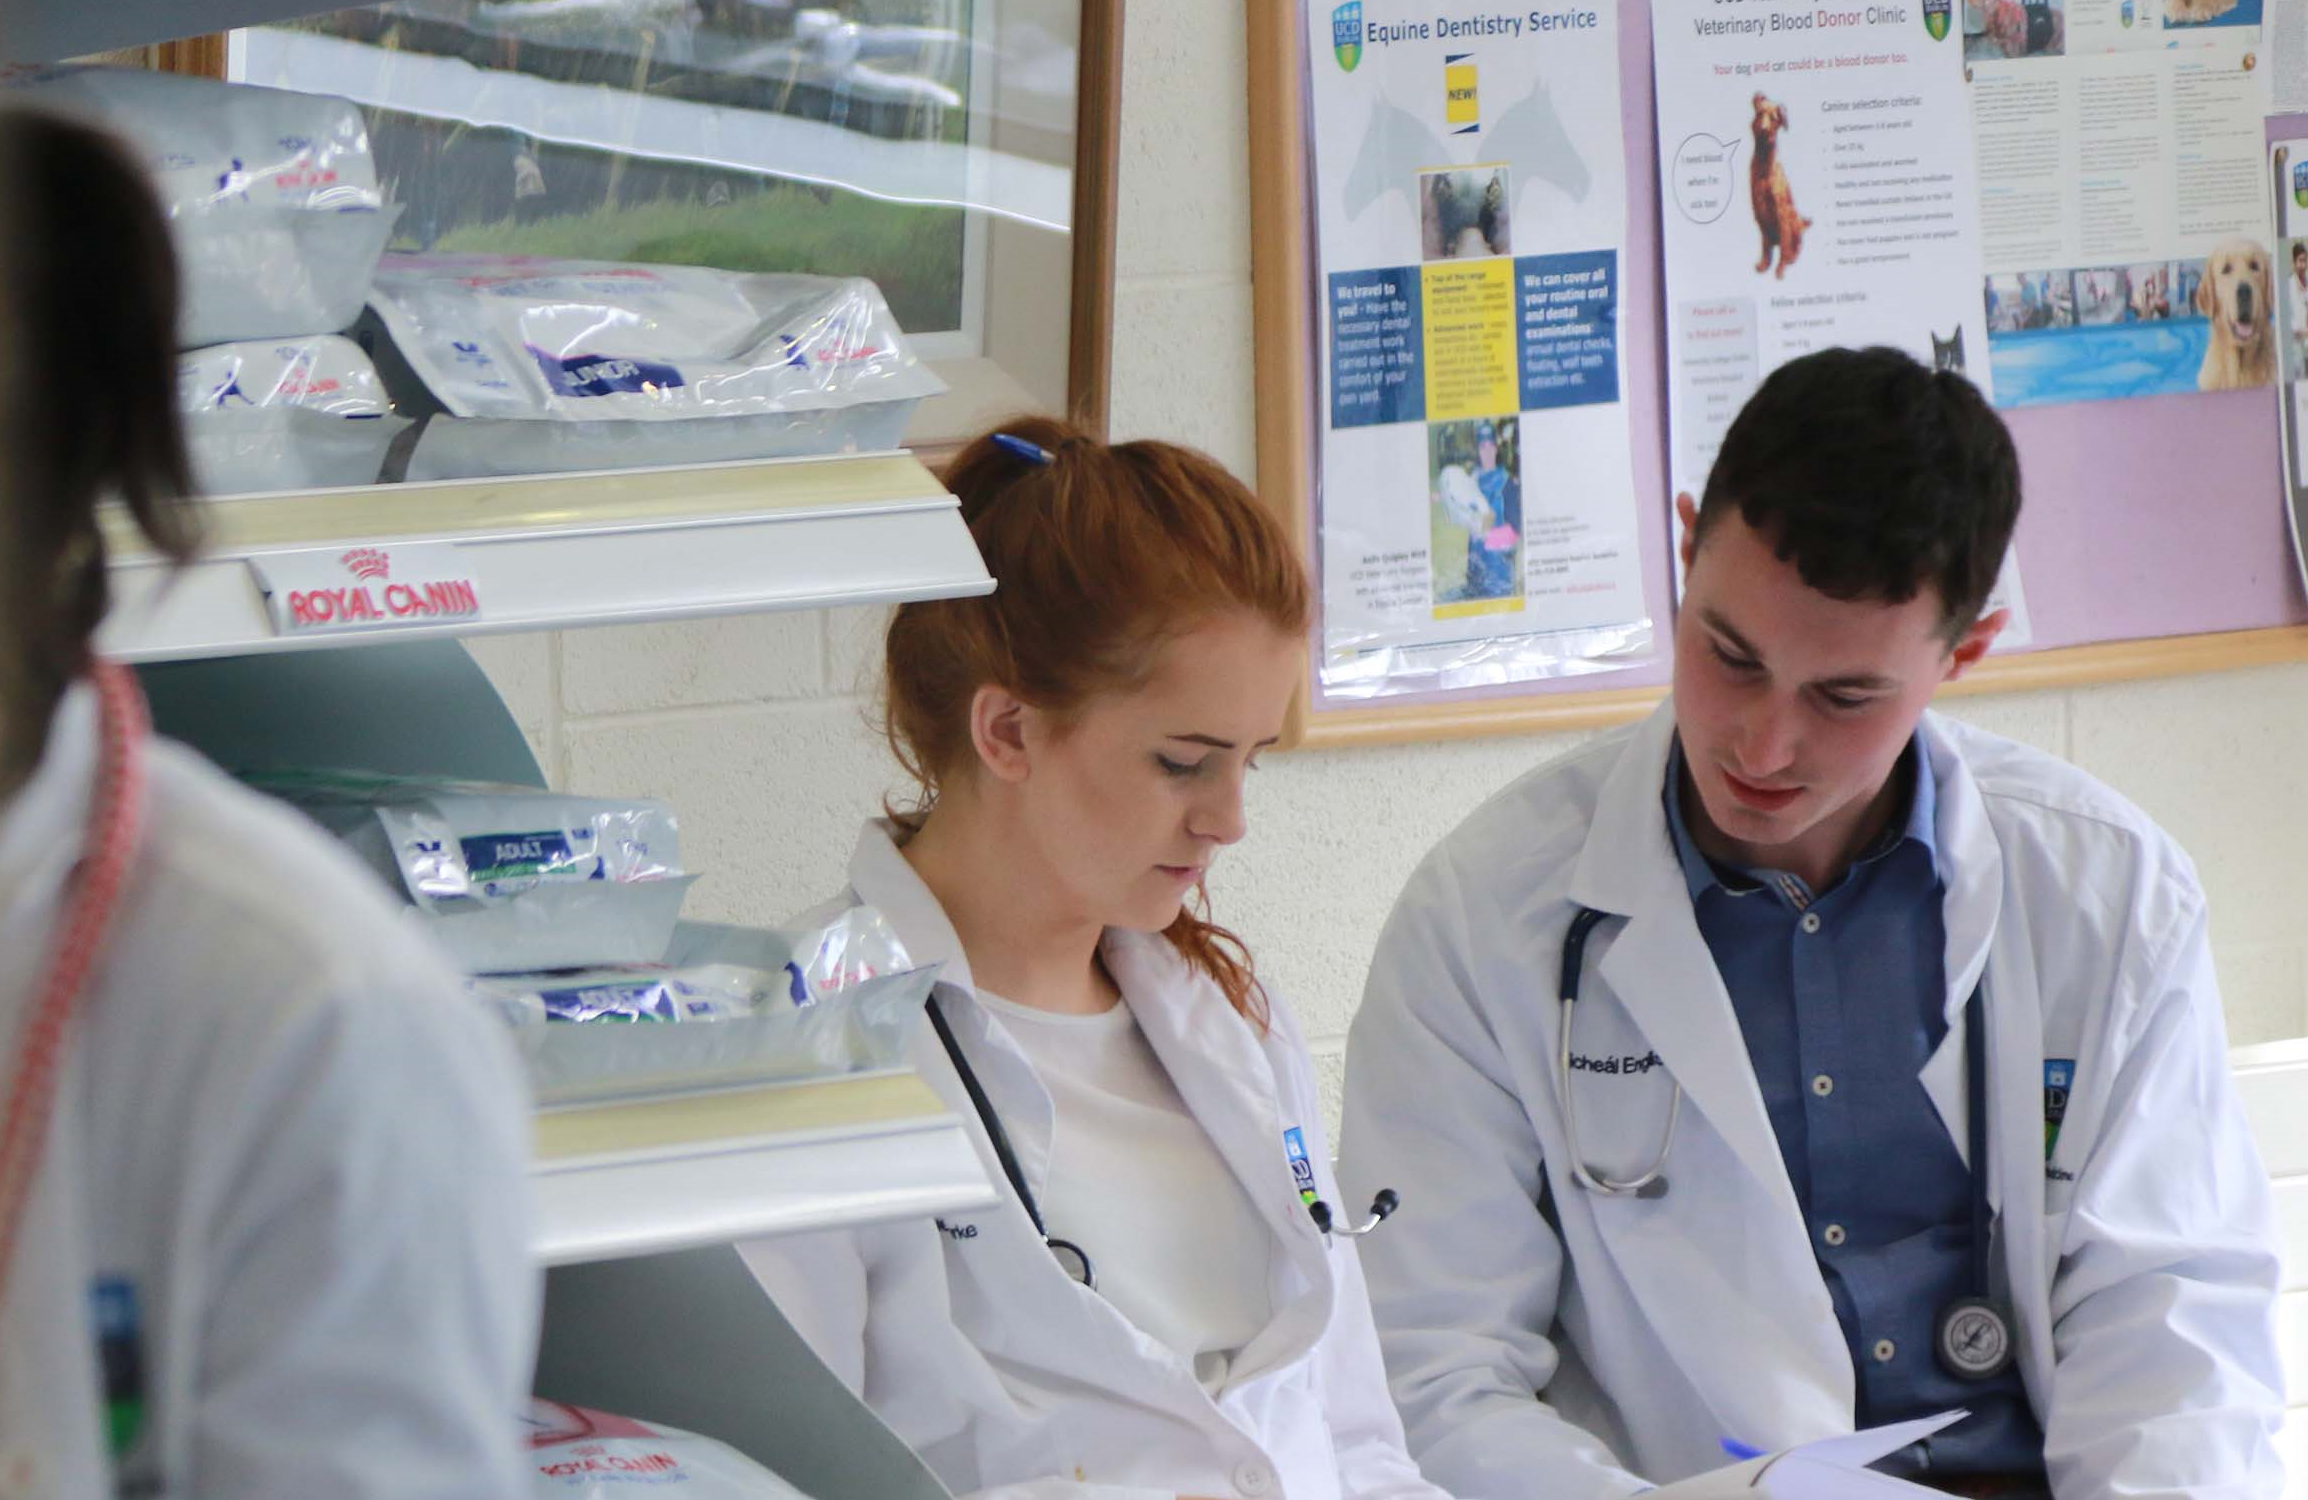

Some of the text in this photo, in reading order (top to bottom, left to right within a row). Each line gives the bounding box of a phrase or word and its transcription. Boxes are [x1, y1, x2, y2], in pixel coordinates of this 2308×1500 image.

[1335, 22, 1361, 35] UCD
[1367, 9, 1597, 46] Equine Dentistry Service
[1695, 6, 1907, 37] Veterinary Blood Donor Clinic
[1714, 64, 1733, 76] Your
[1735, 62, 1752, 76] dog
[1754, 61, 1770, 73] and
[1772, 60, 1786, 72] cat
[1787, 58, 1812, 71] could
[1814, 57, 1825, 69] be
[1835, 54, 1861, 67] blood
[1863, 53, 1889, 66] donor
[1523, 268, 1606, 287] We can cover all
[1337, 284, 1395, 299] We travel to
[1525, 294, 1547, 307] your
[1549, 289, 1586, 303] routine
[1588, 286, 1608, 299] oral
[1391, 300, 1407, 313] the
[1525, 306, 1578, 322] and dental
[289, 579, 479, 626] ROYAL CANIN
[496, 841, 543, 860] ADULT
[1569, 1050, 1619, 1075] icheál
